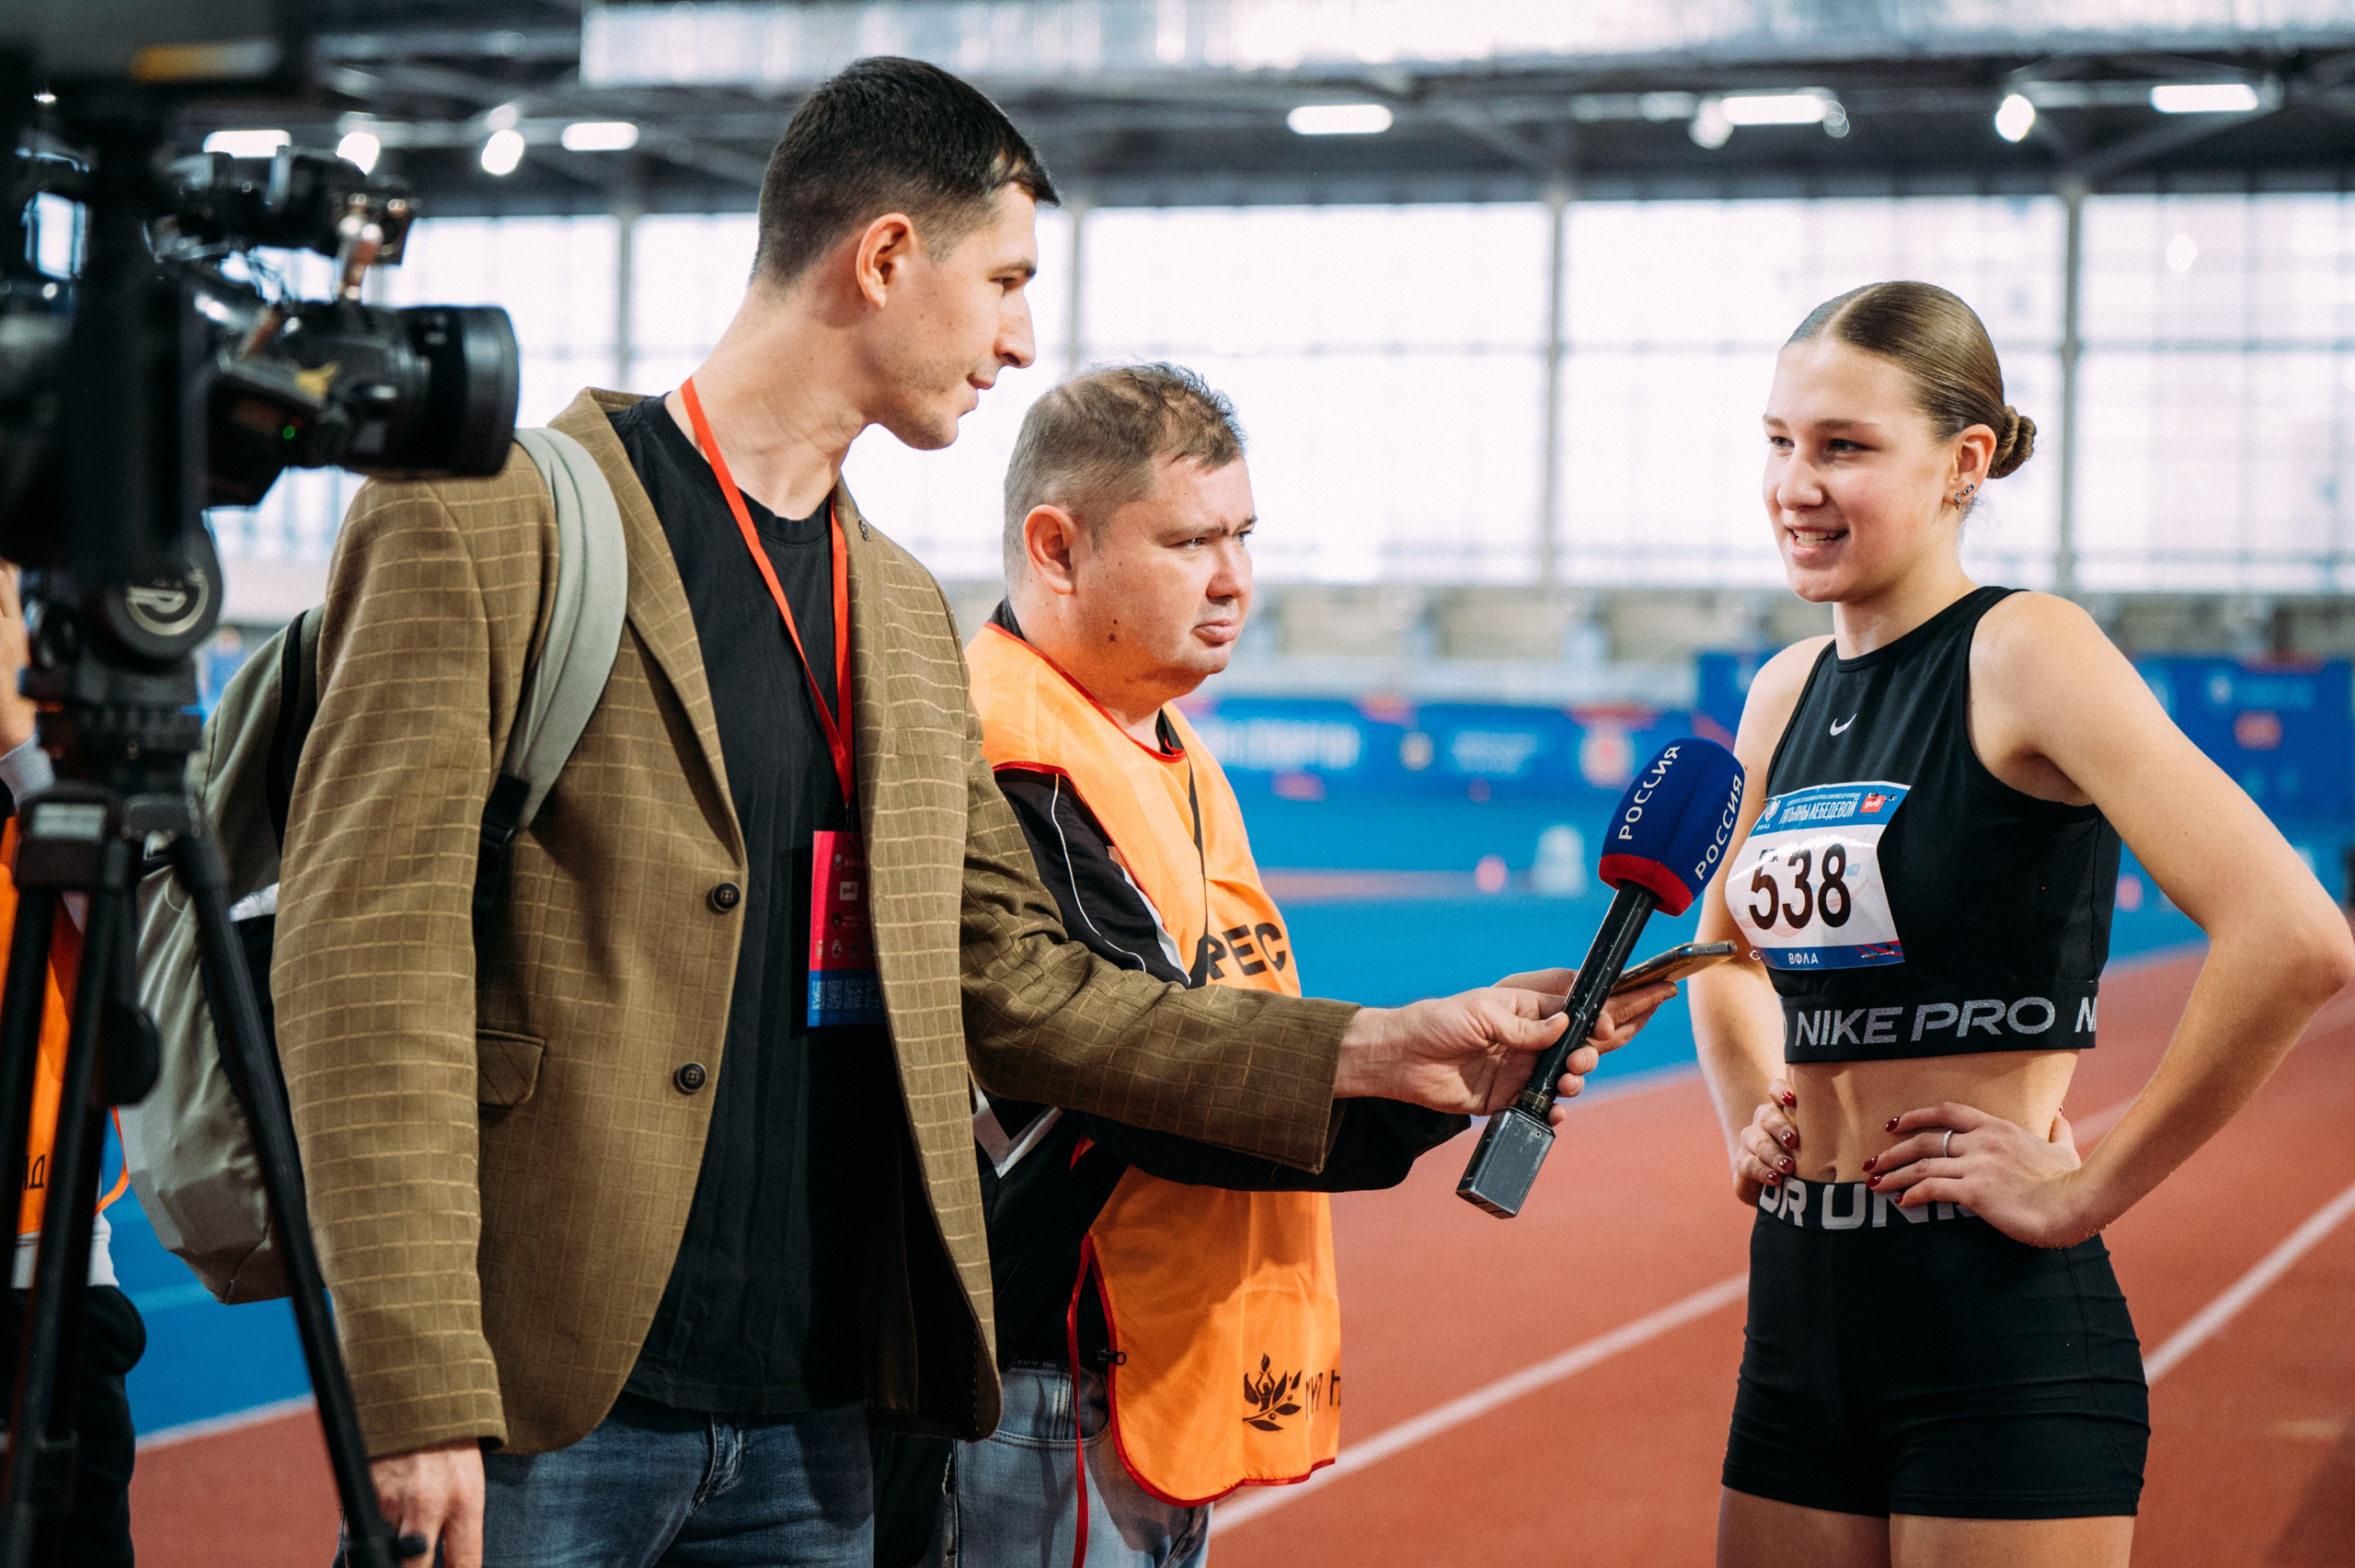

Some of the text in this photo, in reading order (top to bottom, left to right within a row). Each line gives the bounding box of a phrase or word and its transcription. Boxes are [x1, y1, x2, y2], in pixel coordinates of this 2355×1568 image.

[1618, 746, 1681, 840] РОССИЯ
[1694, 774, 1742, 880] РОССИЯ
[1749, 843, 1851, 931] 538
[1787, 952, 1819, 965] ВФЛА
[1795, 1007, 1903, 1047] NIKE
[1911, 997, 2056, 1042] PRO
